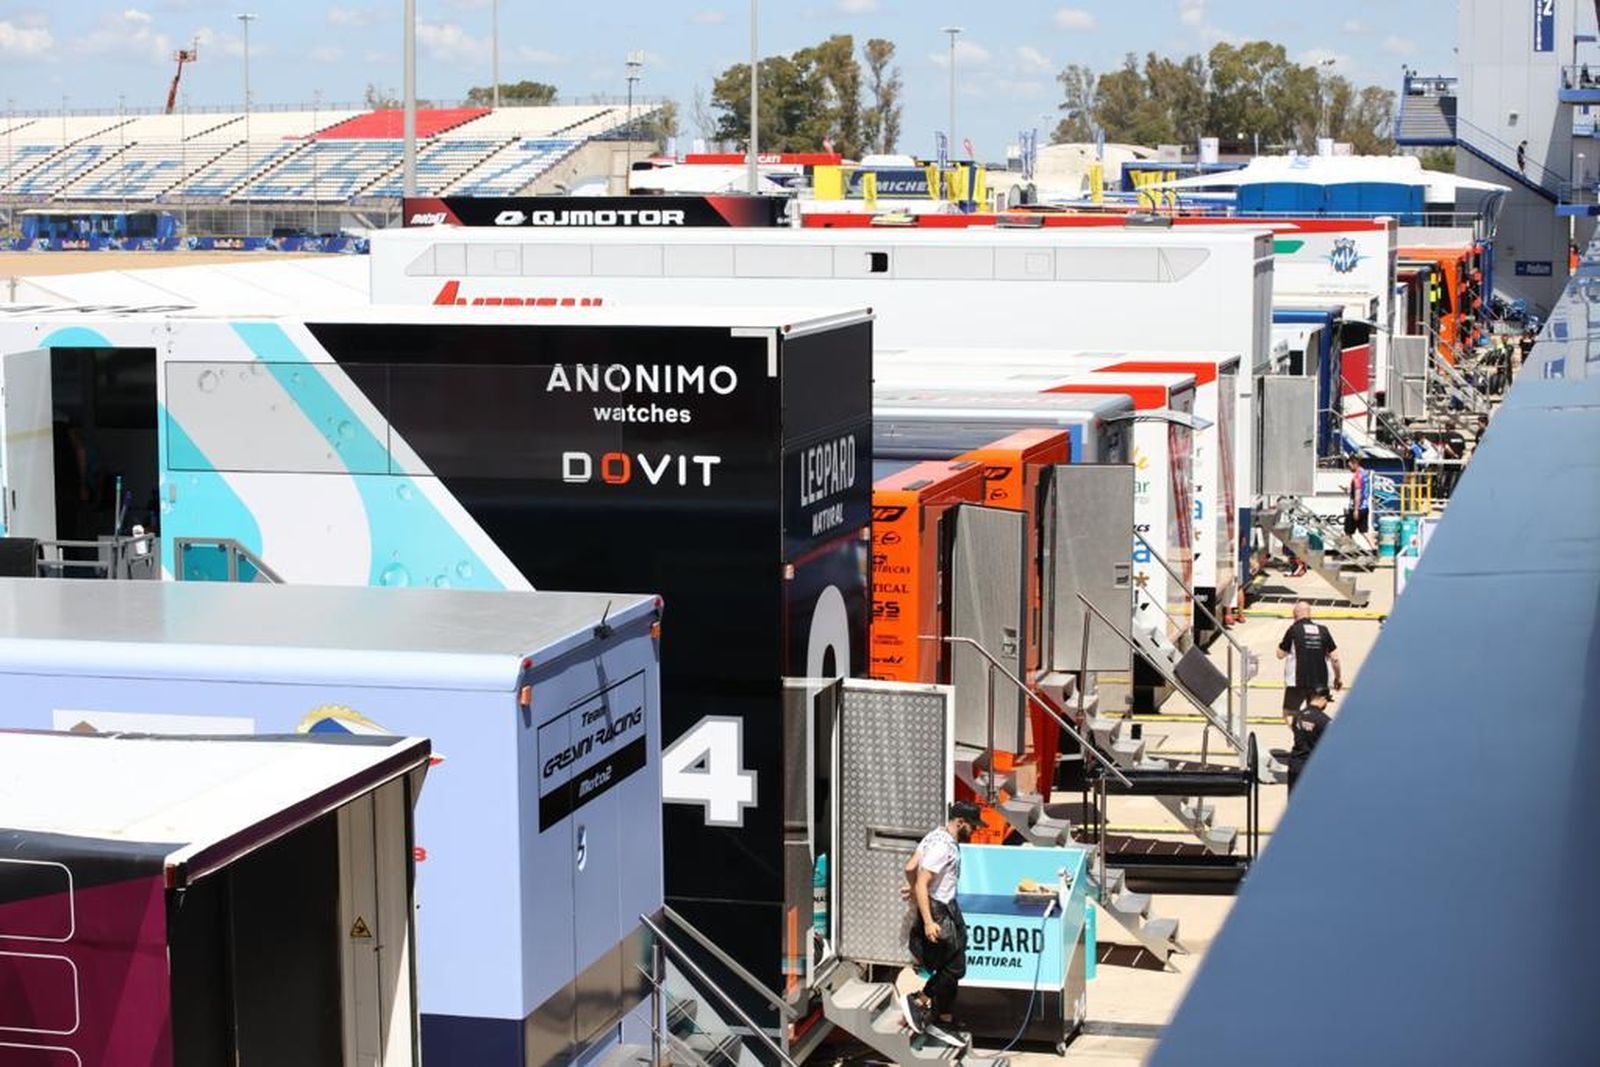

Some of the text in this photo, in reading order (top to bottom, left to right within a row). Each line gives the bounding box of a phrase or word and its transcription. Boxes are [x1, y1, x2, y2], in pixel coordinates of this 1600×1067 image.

[876, 181, 928, 191] MICHE
[532, 210, 685, 225] QJMOTOR
[546, 363, 738, 395] ANONIMO
[594, 404, 691, 423] watches
[562, 452, 721, 486] DOVIT
[801, 434, 856, 507] LEOPARD
[812, 503, 843, 536] NATURAL
[581, 704, 607, 728] Team
[595, 706, 642, 746] RACING
[578, 765, 612, 798] Moto2
[662, 715, 758, 827] 4
[967, 955, 1023, 968] NATURAL
